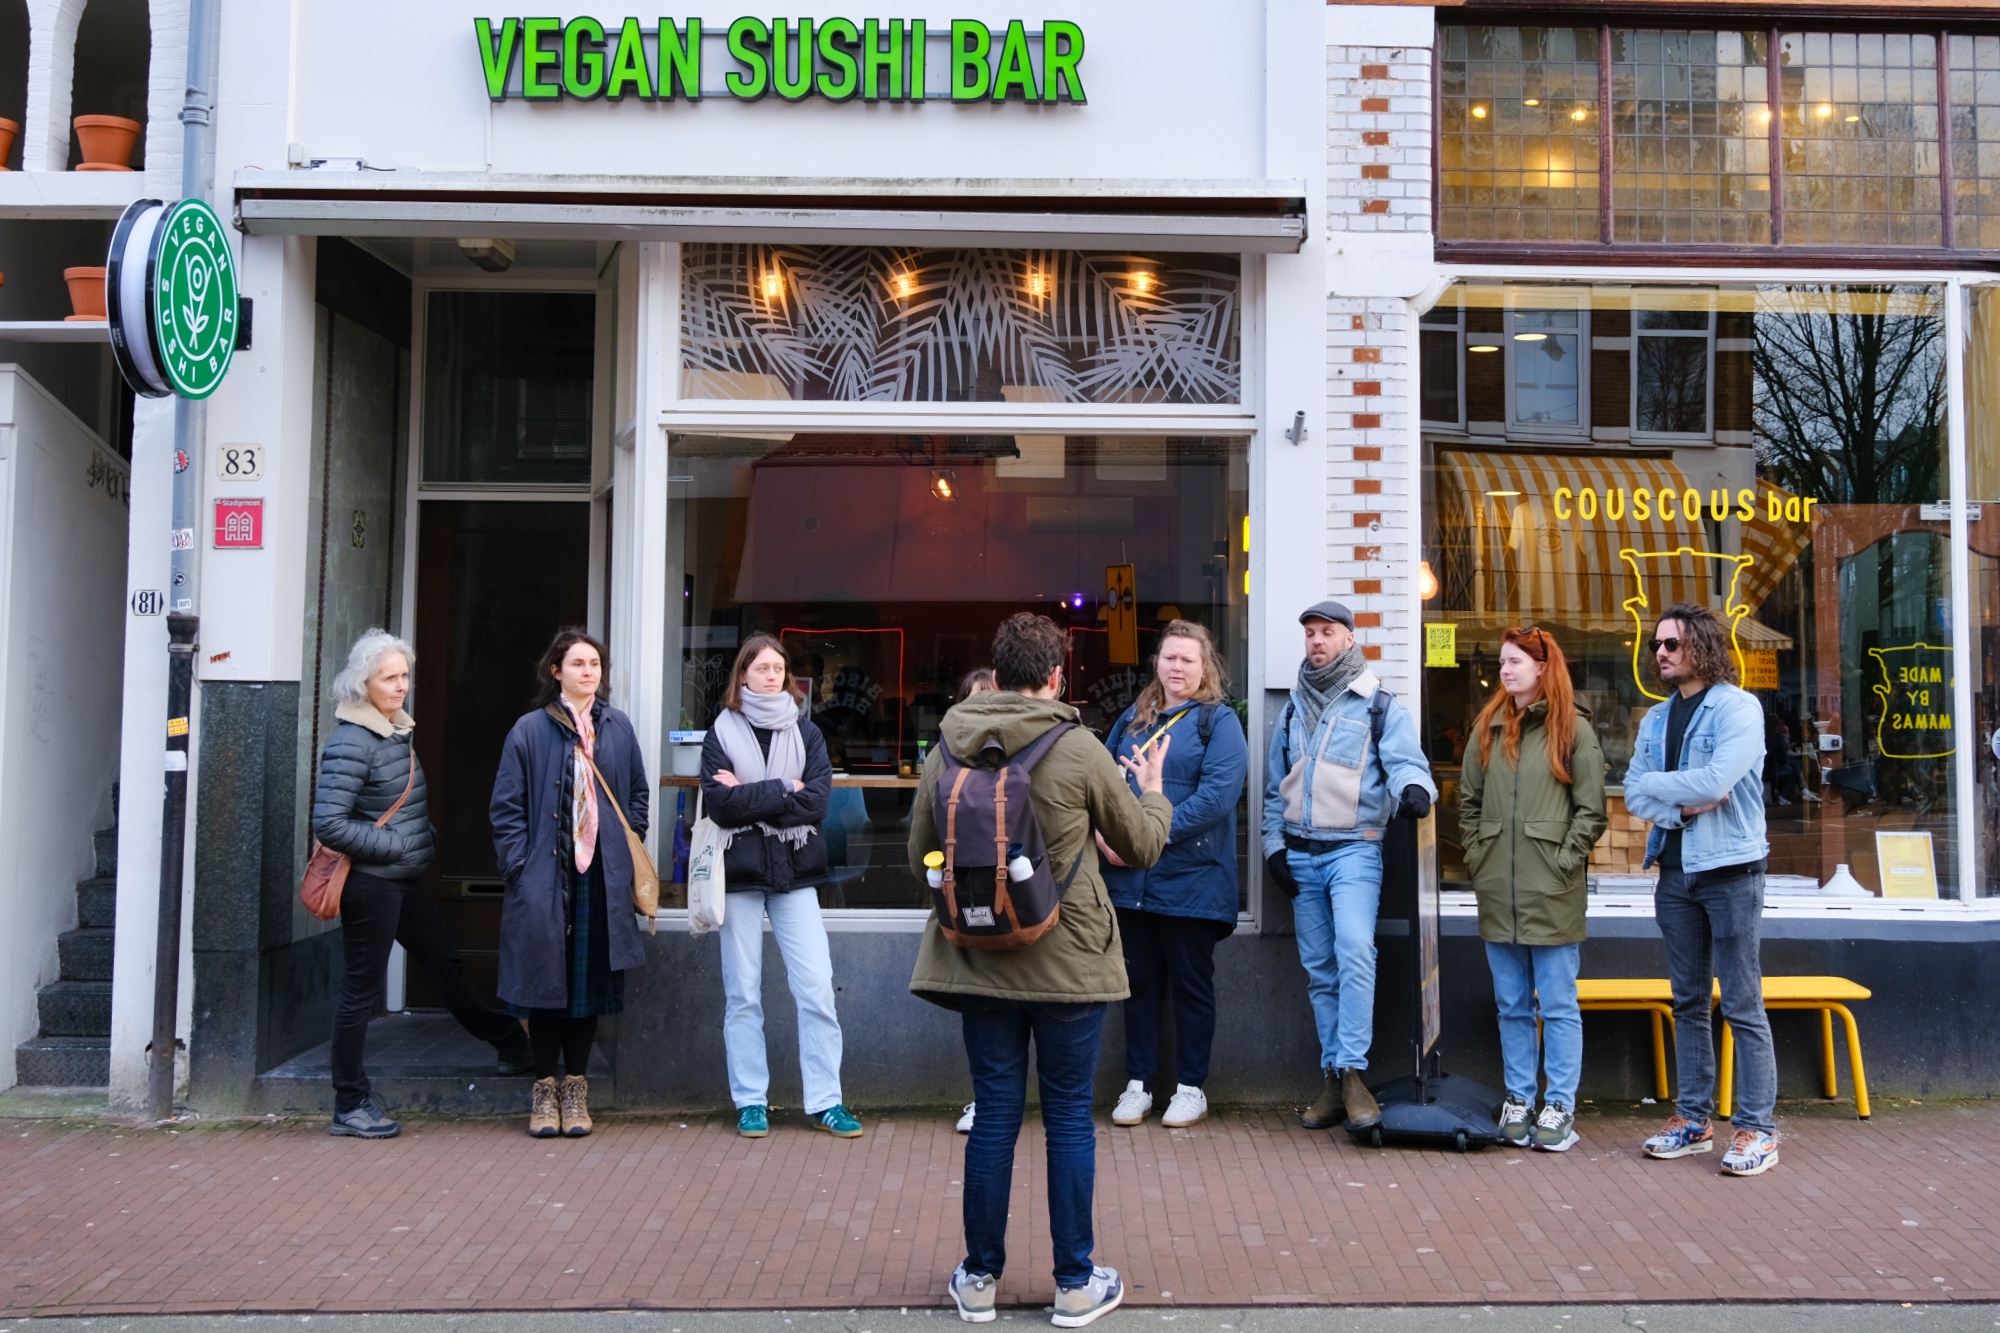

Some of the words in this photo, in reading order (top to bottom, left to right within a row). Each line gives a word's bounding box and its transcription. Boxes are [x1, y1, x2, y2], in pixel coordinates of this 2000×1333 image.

[474, 16, 702, 100] VEGAN
[725, 16, 926, 101] SUSHI
[951, 19, 1087, 103] BAR
[171, 216, 227, 272] VEGAN
[162, 278, 196, 383] SUSHI
[209, 307, 233, 374] BAR
[225, 449, 256, 475] 83
[222, 500, 261, 508] Stadgenoot
[1553, 486, 1756, 522] COUSCOUS
[1767, 490, 1818, 523] bar
[138, 591, 157, 614] 81
